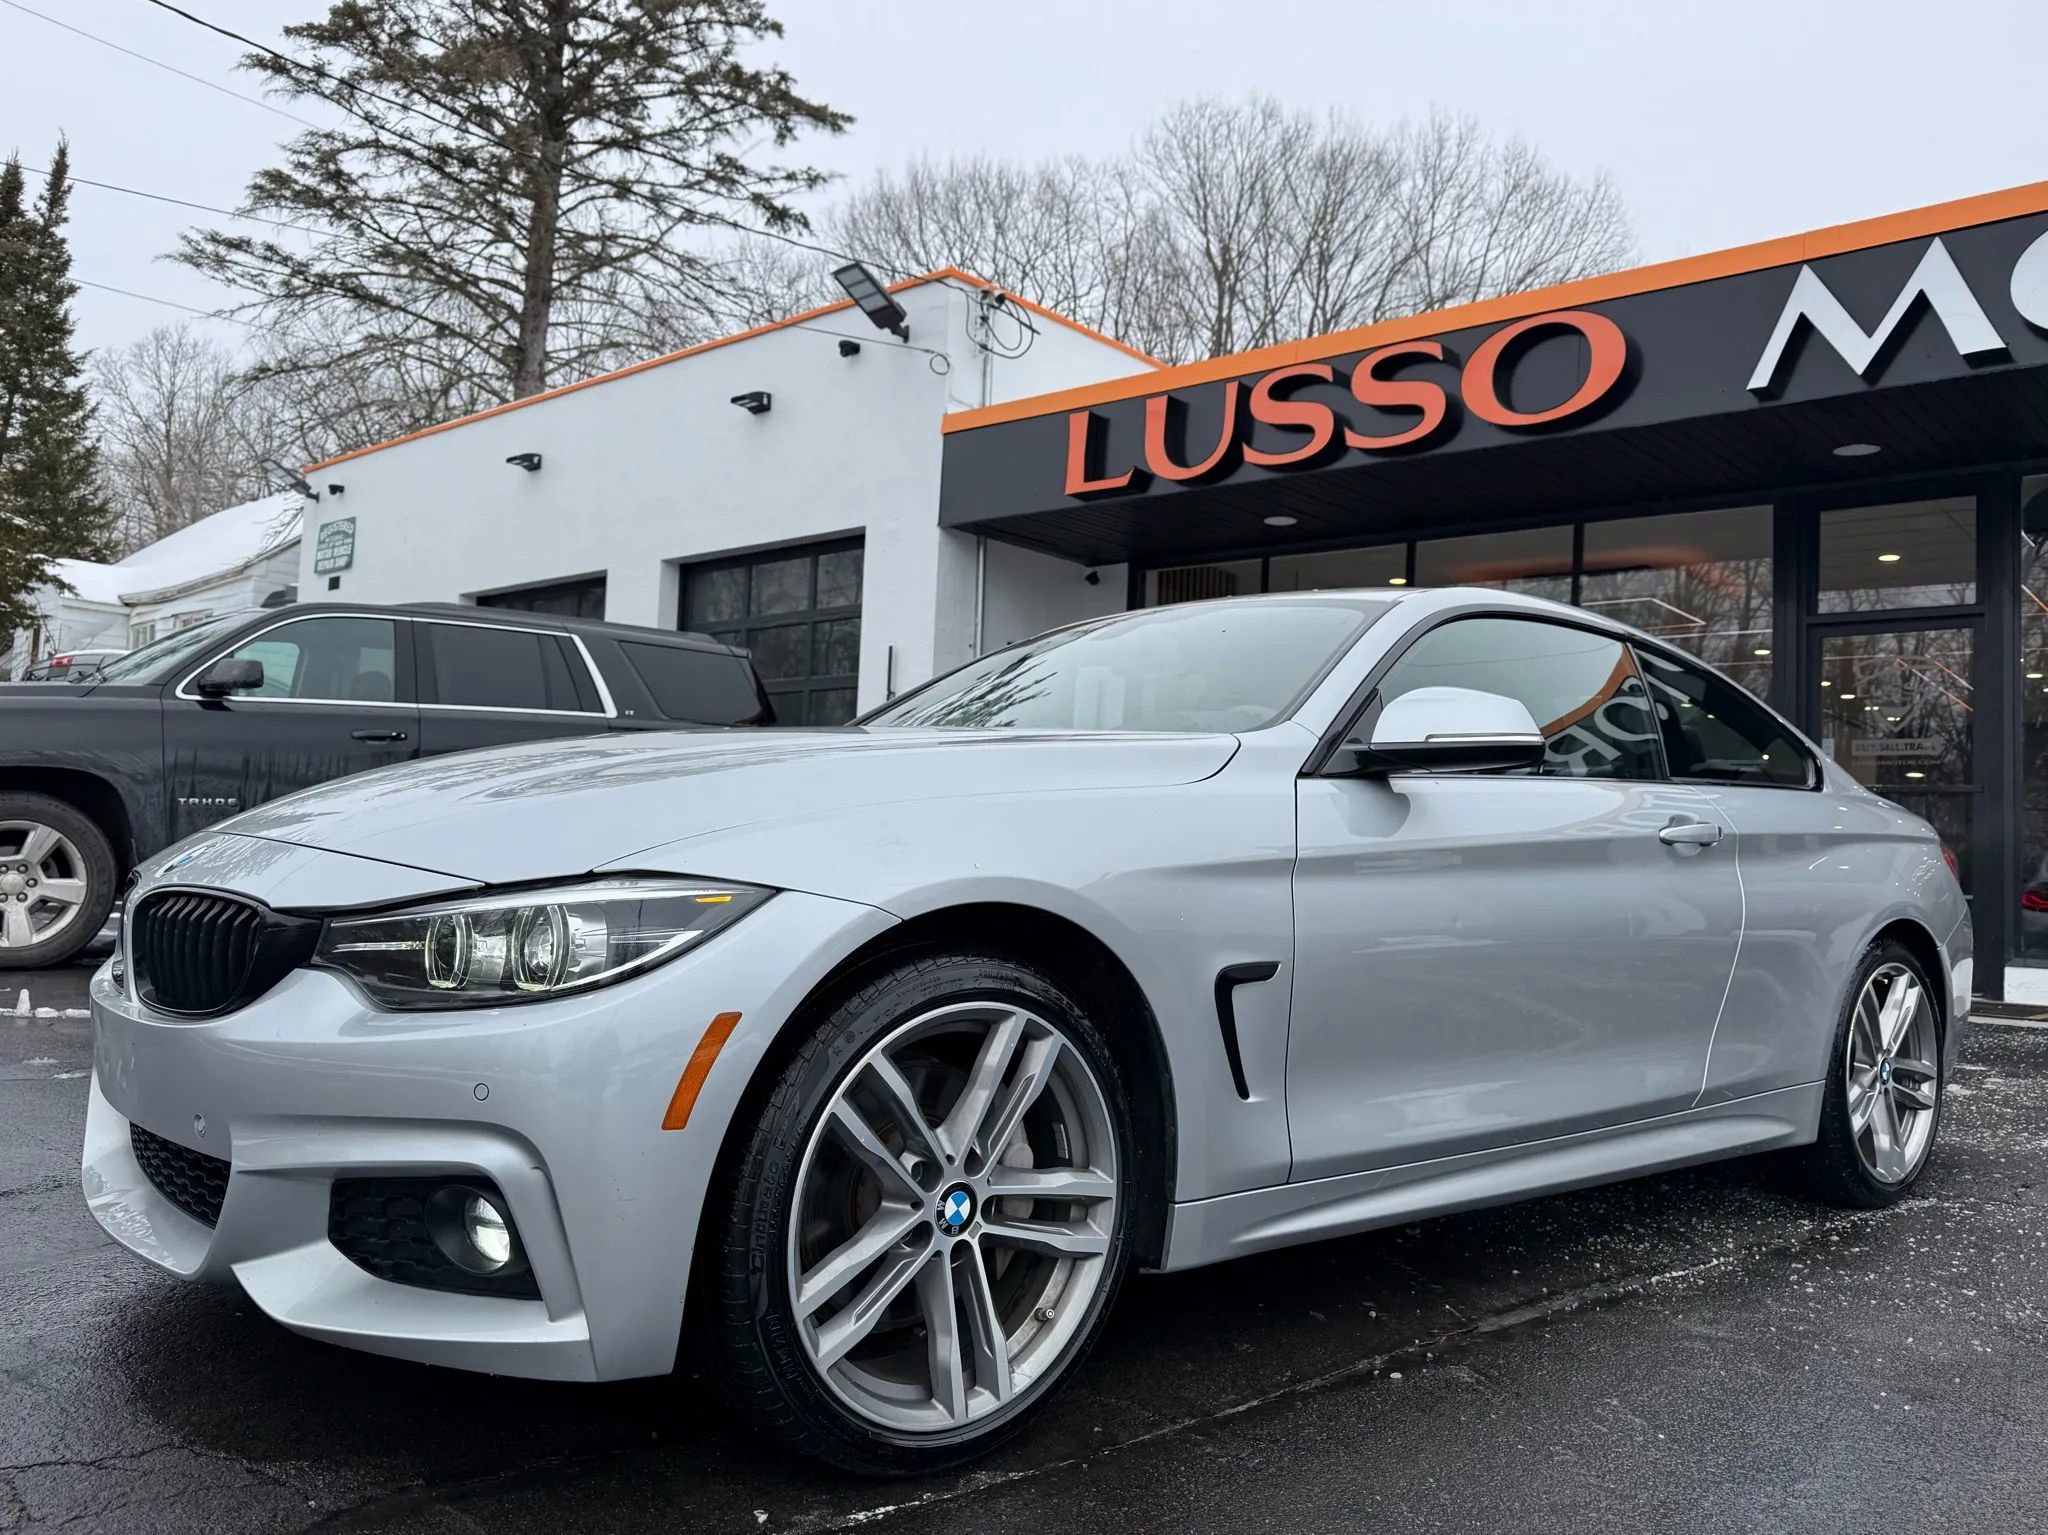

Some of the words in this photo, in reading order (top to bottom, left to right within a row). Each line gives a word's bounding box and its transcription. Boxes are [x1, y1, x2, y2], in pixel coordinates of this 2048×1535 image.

[1065, 311, 1627, 495] LUSSO
[1746, 231, 2048, 391] M
[178, 797, 238, 806] TAHOE
[937, 1199, 960, 1235] BMW
